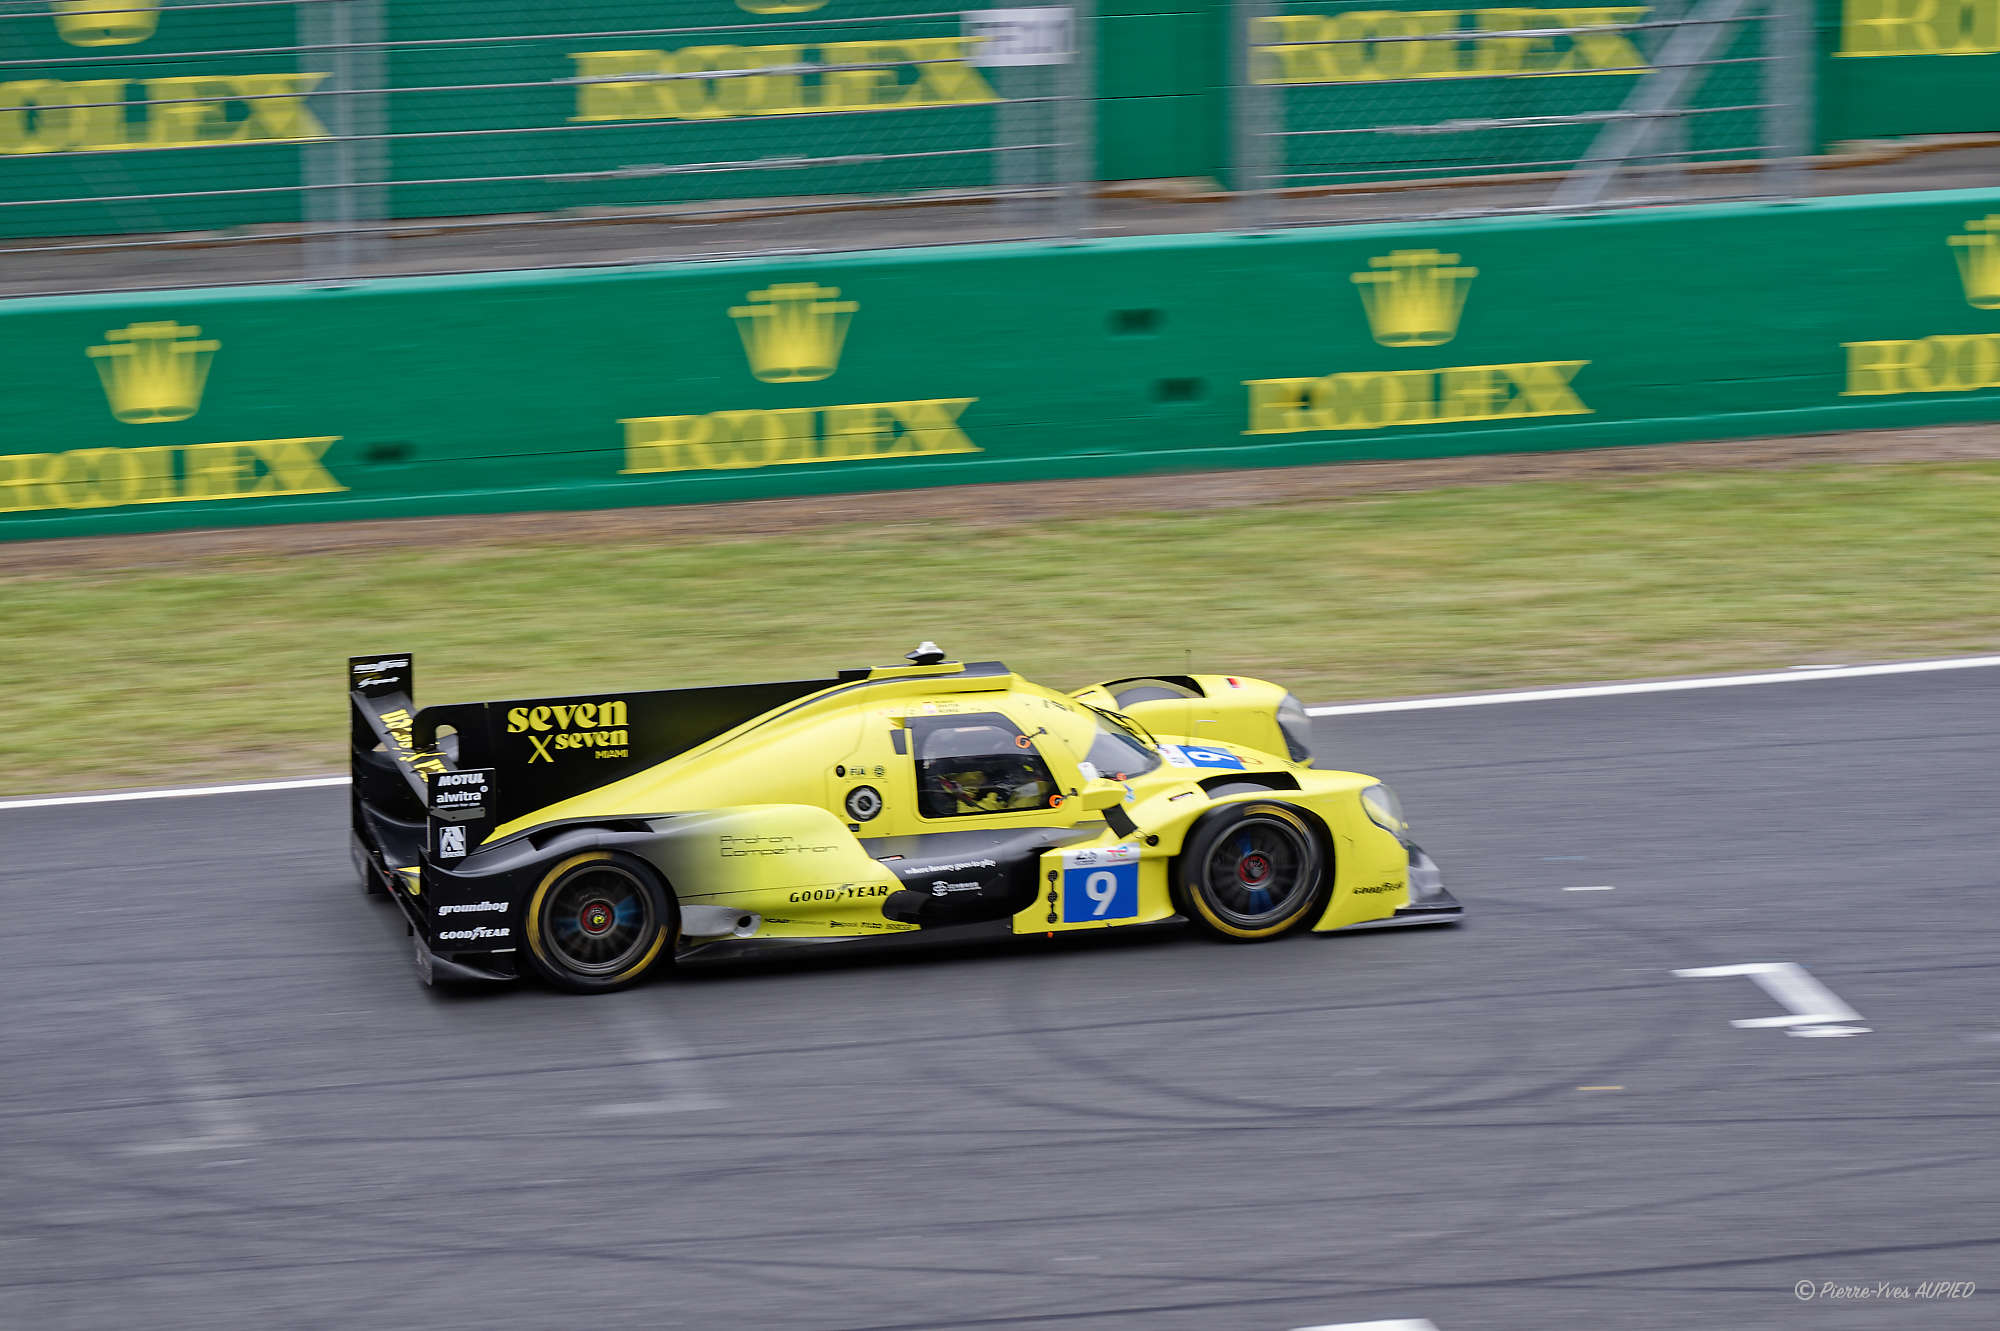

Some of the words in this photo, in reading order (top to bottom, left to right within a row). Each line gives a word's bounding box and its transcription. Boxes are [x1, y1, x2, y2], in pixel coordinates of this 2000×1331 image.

[1248, 6, 1657, 86] ROLEX
[566, 36, 1003, 122] ROLEX
[1241, 360, 1595, 435] ROLEX
[616, 397, 986, 475] ROLEX
[507, 701, 630, 733] seven
[555, 730, 629, 749] seven
[437, 773, 486, 786] MOTUL
[436, 791, 482, 803] alwitra
[789, 884, 889, 903] GOODYEAR
[1086, 871, 1118, 916] 9
[438, 901, 509, 916] groundhog
[439, 927, 511, 940] GOODYEAR
